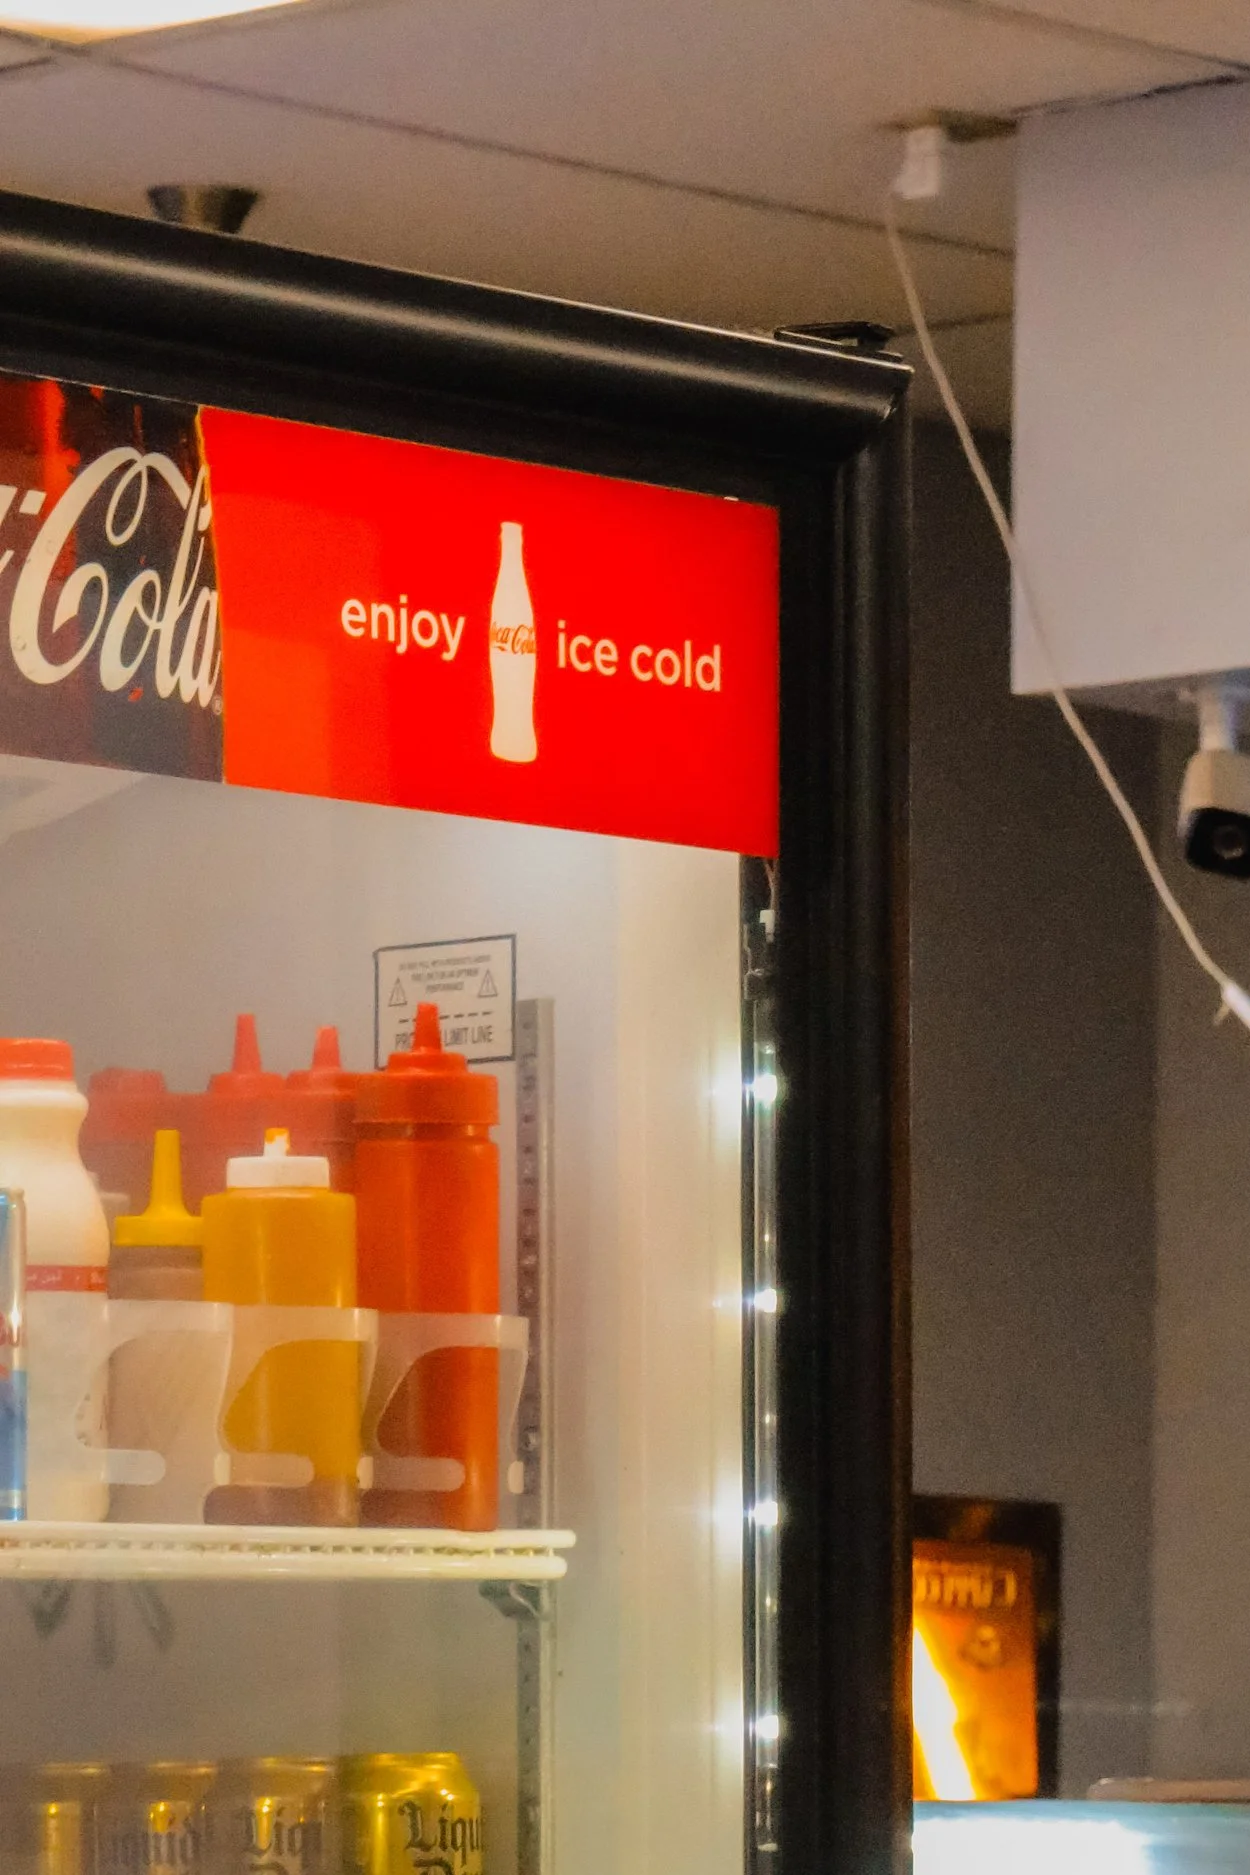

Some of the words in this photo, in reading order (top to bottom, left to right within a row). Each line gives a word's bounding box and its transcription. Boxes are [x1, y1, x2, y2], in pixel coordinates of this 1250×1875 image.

[341, 594, 466, 661] enjoy
[557, 619, 619, 676] ice
[630, 640, 722, 692] cold
[398, 1801, 482, 1868] Liqu
